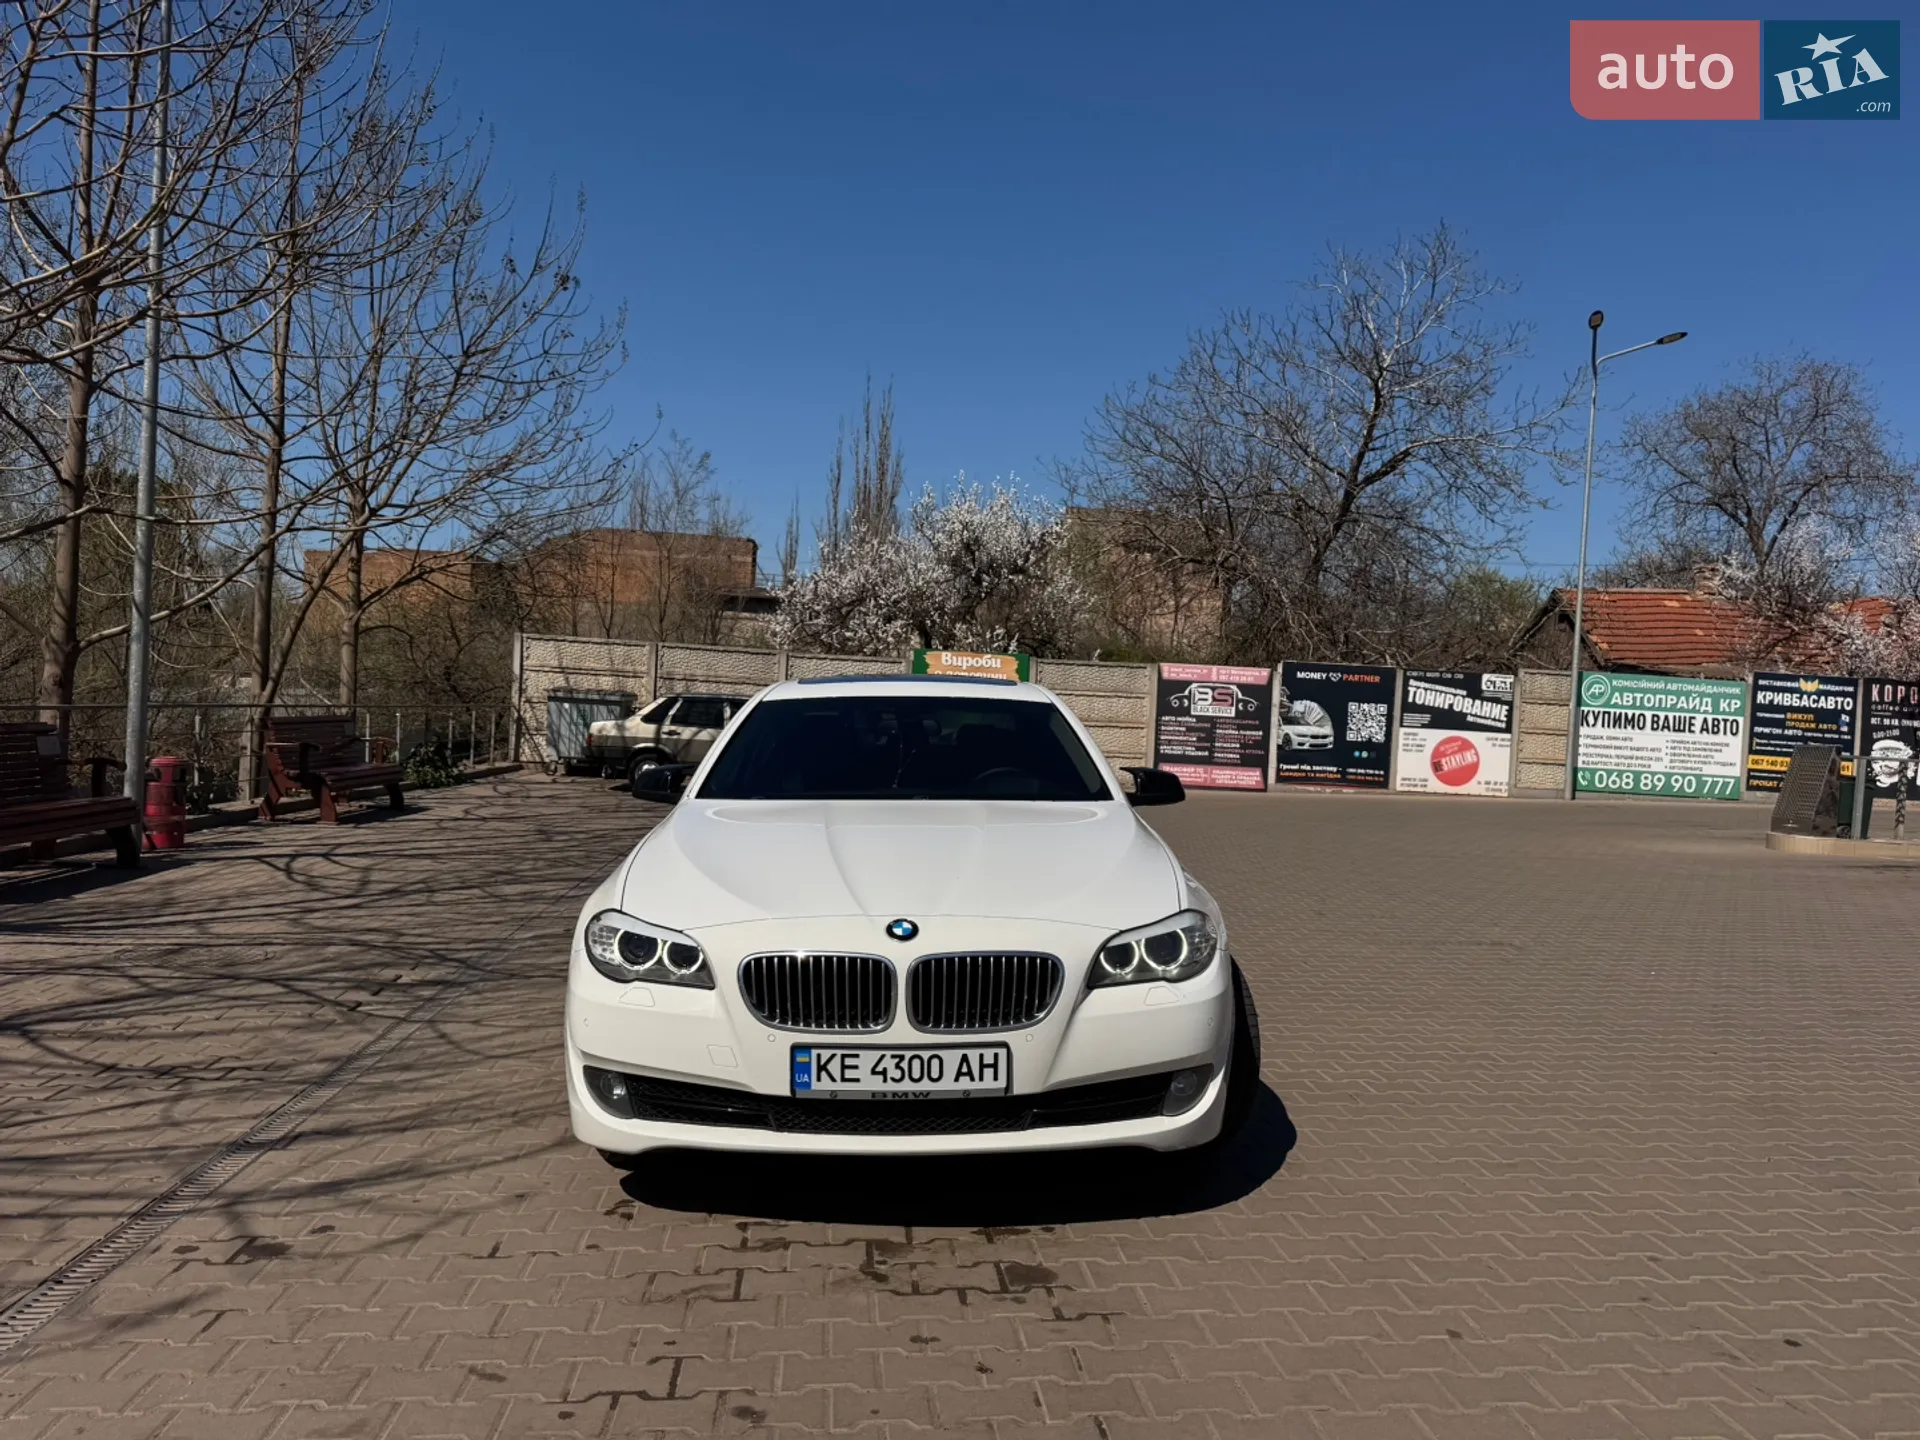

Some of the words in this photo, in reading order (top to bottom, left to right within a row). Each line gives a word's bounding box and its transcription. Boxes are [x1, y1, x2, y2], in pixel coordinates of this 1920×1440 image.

[941, 652, 1001, 669] Вироби
[1296, 671, 1328, 680] MONEY
[1342, 674, 1381, 683] PARTNER
[1611, 679, 1665, 690] КОМІСІЙНИЙ
[1666, 683, 1742, 695] АВТОМАЙДАНЧИК
[1407, 686, 1510, 721] ТОНИРОВАНИЕ
[1610, 692, 1713, 713] АВТОПРАЙД
[1719, 699, 1742, 712] КР
[1756, 691, 1853, 711] КРИВБАСАВТО
[1871, 704, 1900, 712] coffee
[1581, 709, 1646, 731] КУПИМО
[1651, 714, 1696, 733] ВАШЕ
[1699, 717, 1740, 736] АВТО
[1785, 712, 1814, 721] ВИКУП
[1754, 726, 1783, 734] ПРИГОН
[1783, 728, 1803, 736] АВТО
[1785, 721, 1817, 729] ПРОДАЖ
[1751, 758, 1764, 766] 067
[1594, 770, 1634, 789] 068
[1639, 773, 1665, 791] 89
[1671, 775, 1697, 793] 90
[1701, 777, 1735, 795] 777
[816, 1053, 860, 1083] KE
[870, 1053, 944, 1083] 4300
[953, 1052, 999, 1082] AH
[795, 1073, 809, 1083] UA
